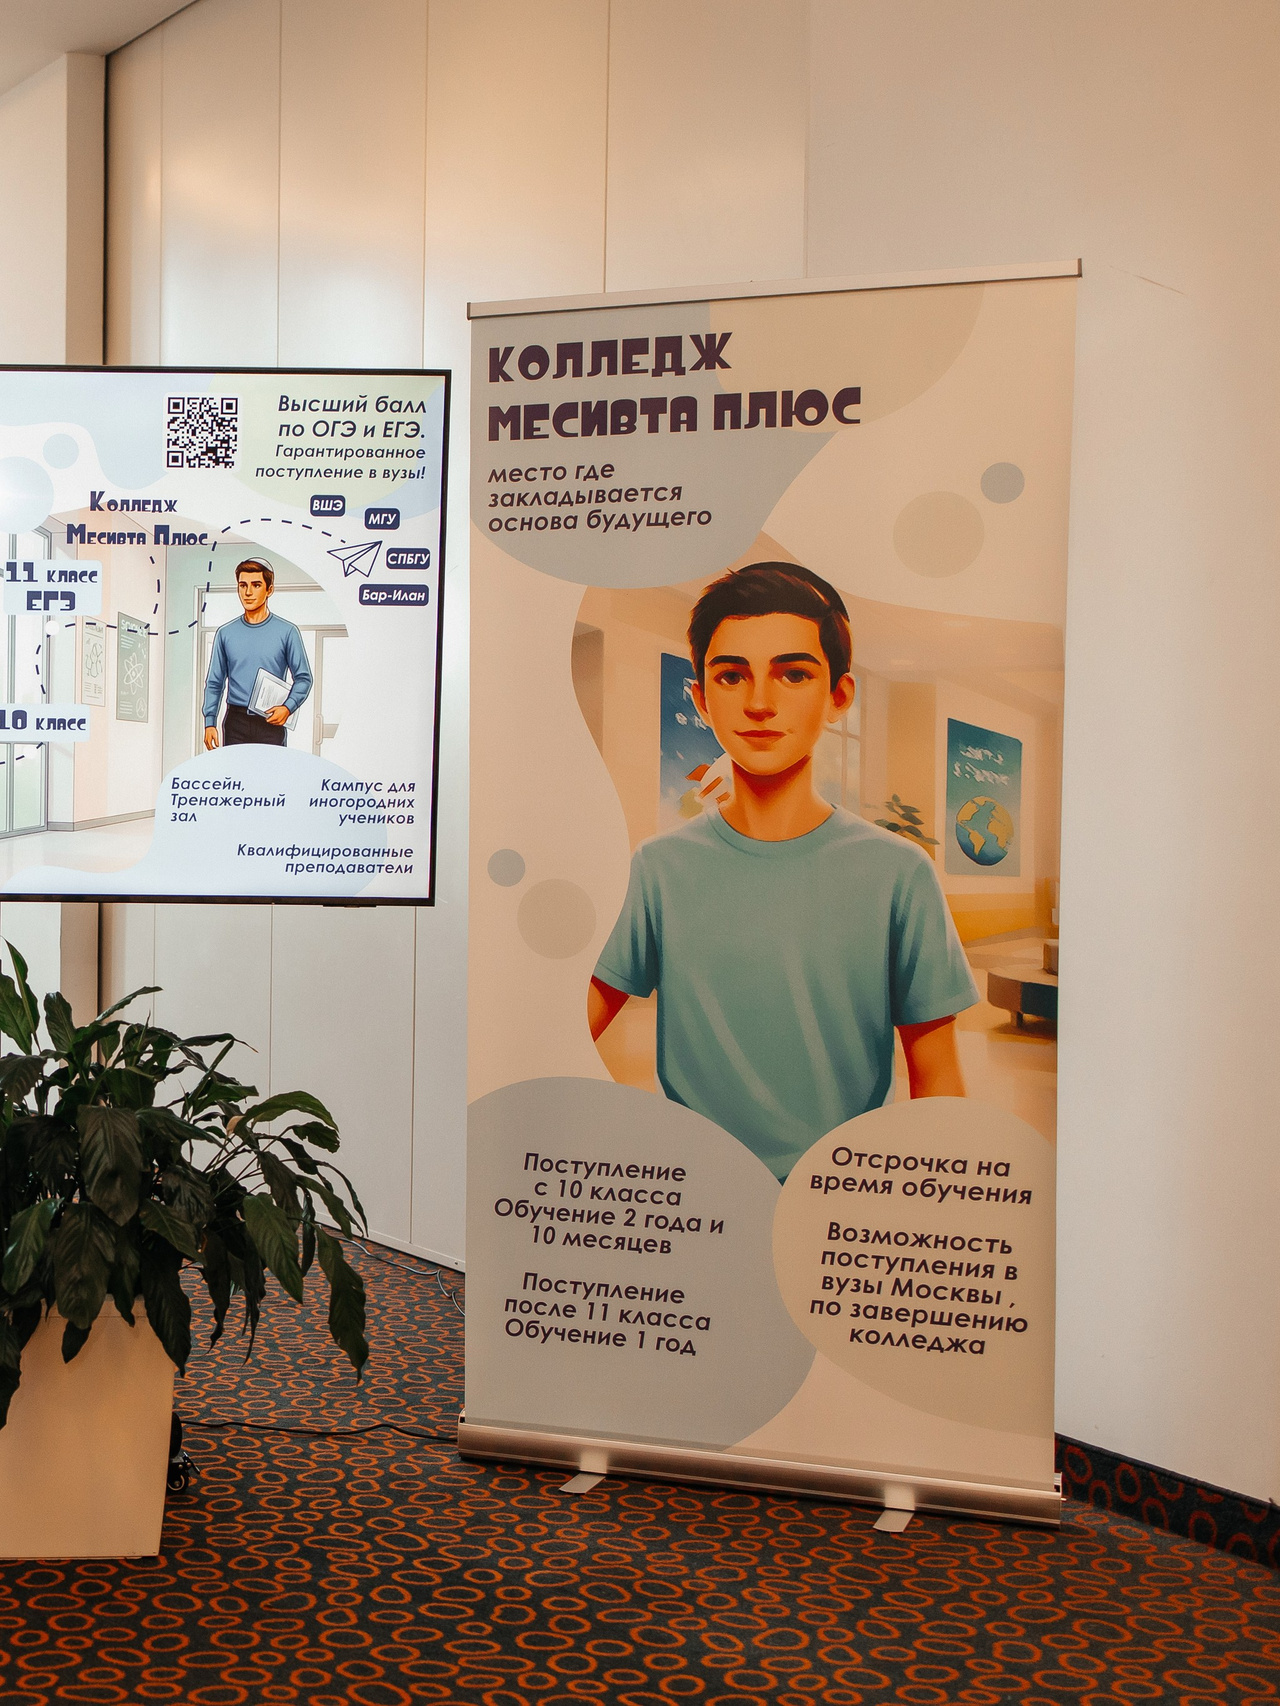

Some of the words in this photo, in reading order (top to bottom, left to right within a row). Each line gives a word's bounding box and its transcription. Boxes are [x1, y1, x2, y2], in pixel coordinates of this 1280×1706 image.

[488, 331, 733, 383] КОЛЛЕДЖ
[278, 394, 368, 413] Высший
[375, 395, 427, 414] балл
[488, 395, 698, 442] МЕСИВТА
[713, 386, 862, 431] ПЛЮС
[278, 424, 305, 437] по
[312, 419, 357, 438] ОГЭ
[363, 425, 376, 438] и
[382, 420, 425, 439] ЕГЭ.
[275, 444, 426, 461] Гарантированное
[255, 467, 364, 481] поступление
[368, 468, 377, 479] в
[382, 465, 426, 482] вузы!
[487, 465, 567, 483] место
[574, 463, 615, 482] где
[89, 490, 178, 514] Колледж
[312, 499, 344, 512] ВШЭ
[488, 486, 683, 508] закладывается
[367, 513, 397, 525] МГУ
[488, 514, 579, 533] основа
[586, 508, 712, 534] будущего
[66, 523, 147, 545] Месивта
[153, 524, 209, 546] Плюс
[387, 553, 431, 565] СПБГУ
[5, 561, 39, 583] 11
[46, 569, 98, 584] класс
[26, 590, 76, 612] ЕГЭ
[361, 589, 426, 603] Бар-Илан
[35, 717, 87, 731] класс
[170, 775, 246, 793] Бассейн,
[321, 778, 383, 795] Кампус
[387, 782, 416, 794] для
[171, 793, 286, 810] Тренажерный
[309, 797, 415, 811] иногородних
[170, 812, 197, 822] зал
[338, 814, 415, 827] учеников
[237, 843, 414, 860] Квалифицированные
[285, 863, 414, 876] преподаватели
[523, 1152, 687, 1182] Поступление
[831, 1146, 968, 1175] Отсрочка
[976, 1160, 1011, 1178] на
[534, 1181, 548, 1196] с
[559, 1179, 583, 1199] 10
[589, 1185, 682, 1207] класса
[810, 1174, 894, 1195] время
[901, 1177, 1033, 1205] обучения
[494, 1197, 616, 1226] Обучение
[623, 1207, 637, 1227] 2
[644, 1214, 702, 1234] года
[709, 1219, 725, 1234] и
[533, 1225, 556, 1245] 10
[561, 1232, 672, 1255] месяцев
[827, 1221, 1013, 1255] Возможность
[820, 1250, 995, 1279] поступления
[1004, 1265, 1018, 1281] в
[522, 1271, 685, 1304] Поступление
[821, 1275, 883, 1296] вузы
[890, 1277, 1002, 1305] Москвы
[504, 1298, 577, 1319] после
[587, 1301, 609, 1322] 11
[618, 1309, 711, 1331] класса
[809, 1299, 842, 1316] по
[849, 1302, 1028, 1333] завершению
[505, 1318, 627, 1348] Обучение
[638, 1330, 646, 1349] 1
[655, 1336, 697, 1357] год
[849, 1328, 986, 1355] колледжа
